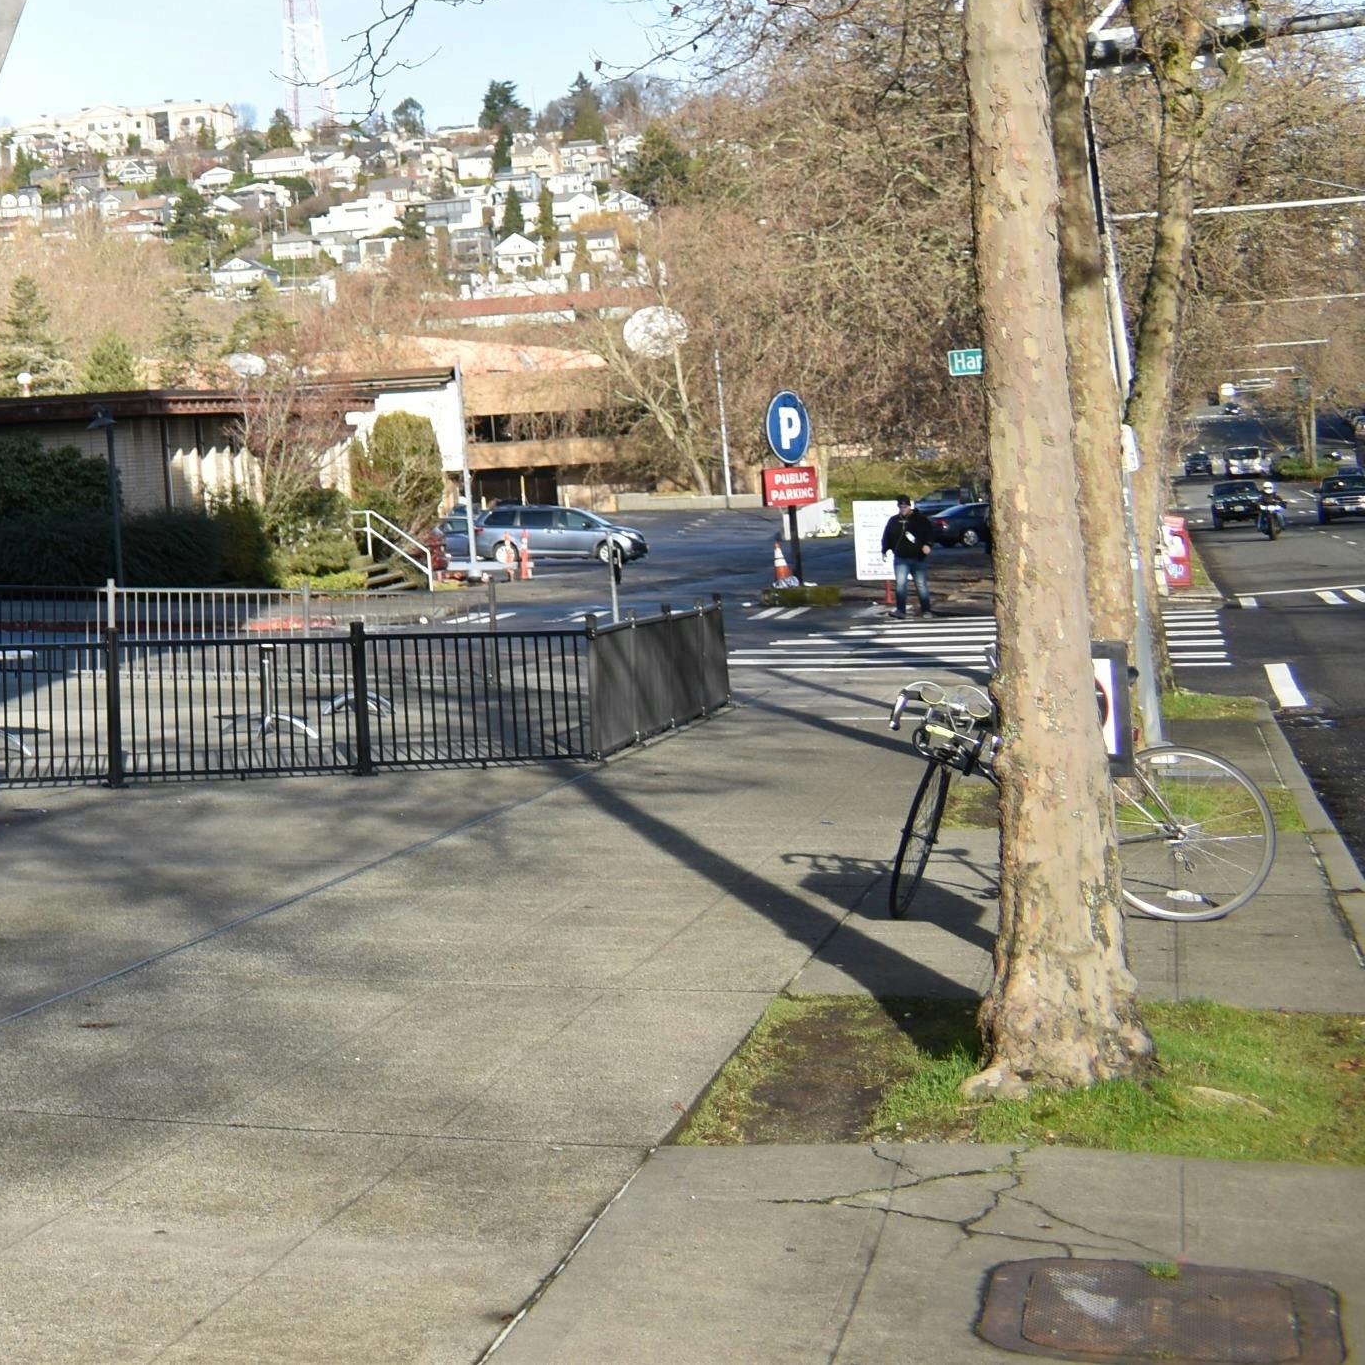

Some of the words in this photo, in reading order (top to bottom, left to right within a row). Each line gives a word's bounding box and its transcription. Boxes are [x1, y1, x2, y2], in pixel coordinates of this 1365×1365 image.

[778, 406, 801, 450] P
[774, 471, 810, 485] PUBLIC
[770, 486, 815, 501] PARKING
